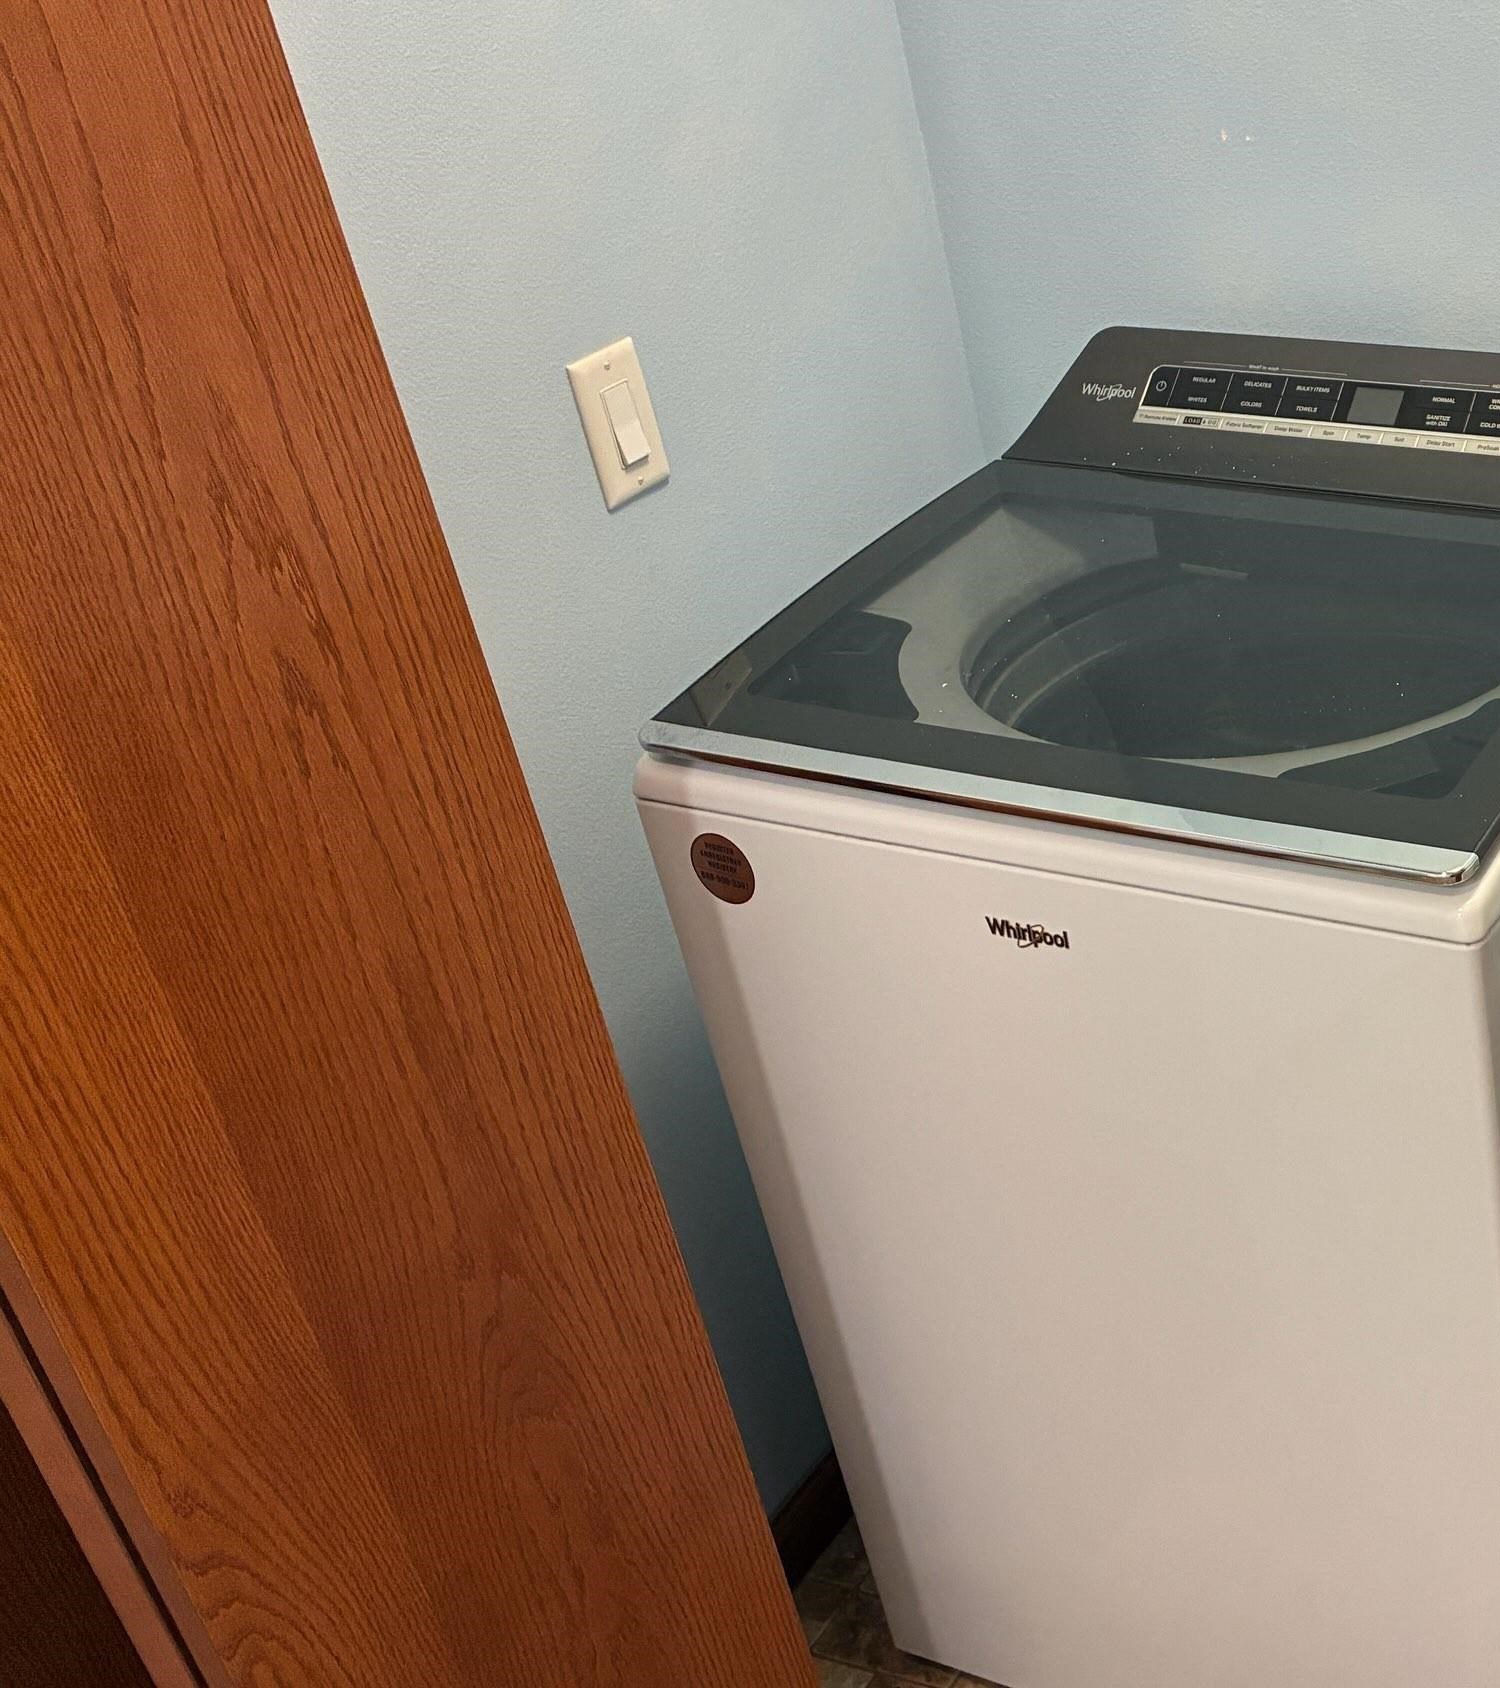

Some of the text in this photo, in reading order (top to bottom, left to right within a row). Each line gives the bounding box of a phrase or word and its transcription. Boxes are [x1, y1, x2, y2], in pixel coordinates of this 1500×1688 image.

[1192, 376, 1216, 384] REGULAR
[1244, 380, 1272, 389] DELICATES
[1082, 383, 1136, 402] Whirlpool
[1240, 400, 1262, 408] COLORS
[1432, 396, 1456, 404] NORMAL
[1296, 405, 1318, 413] TOWELS
[985, 916, 1070, 949] Whirlpool
